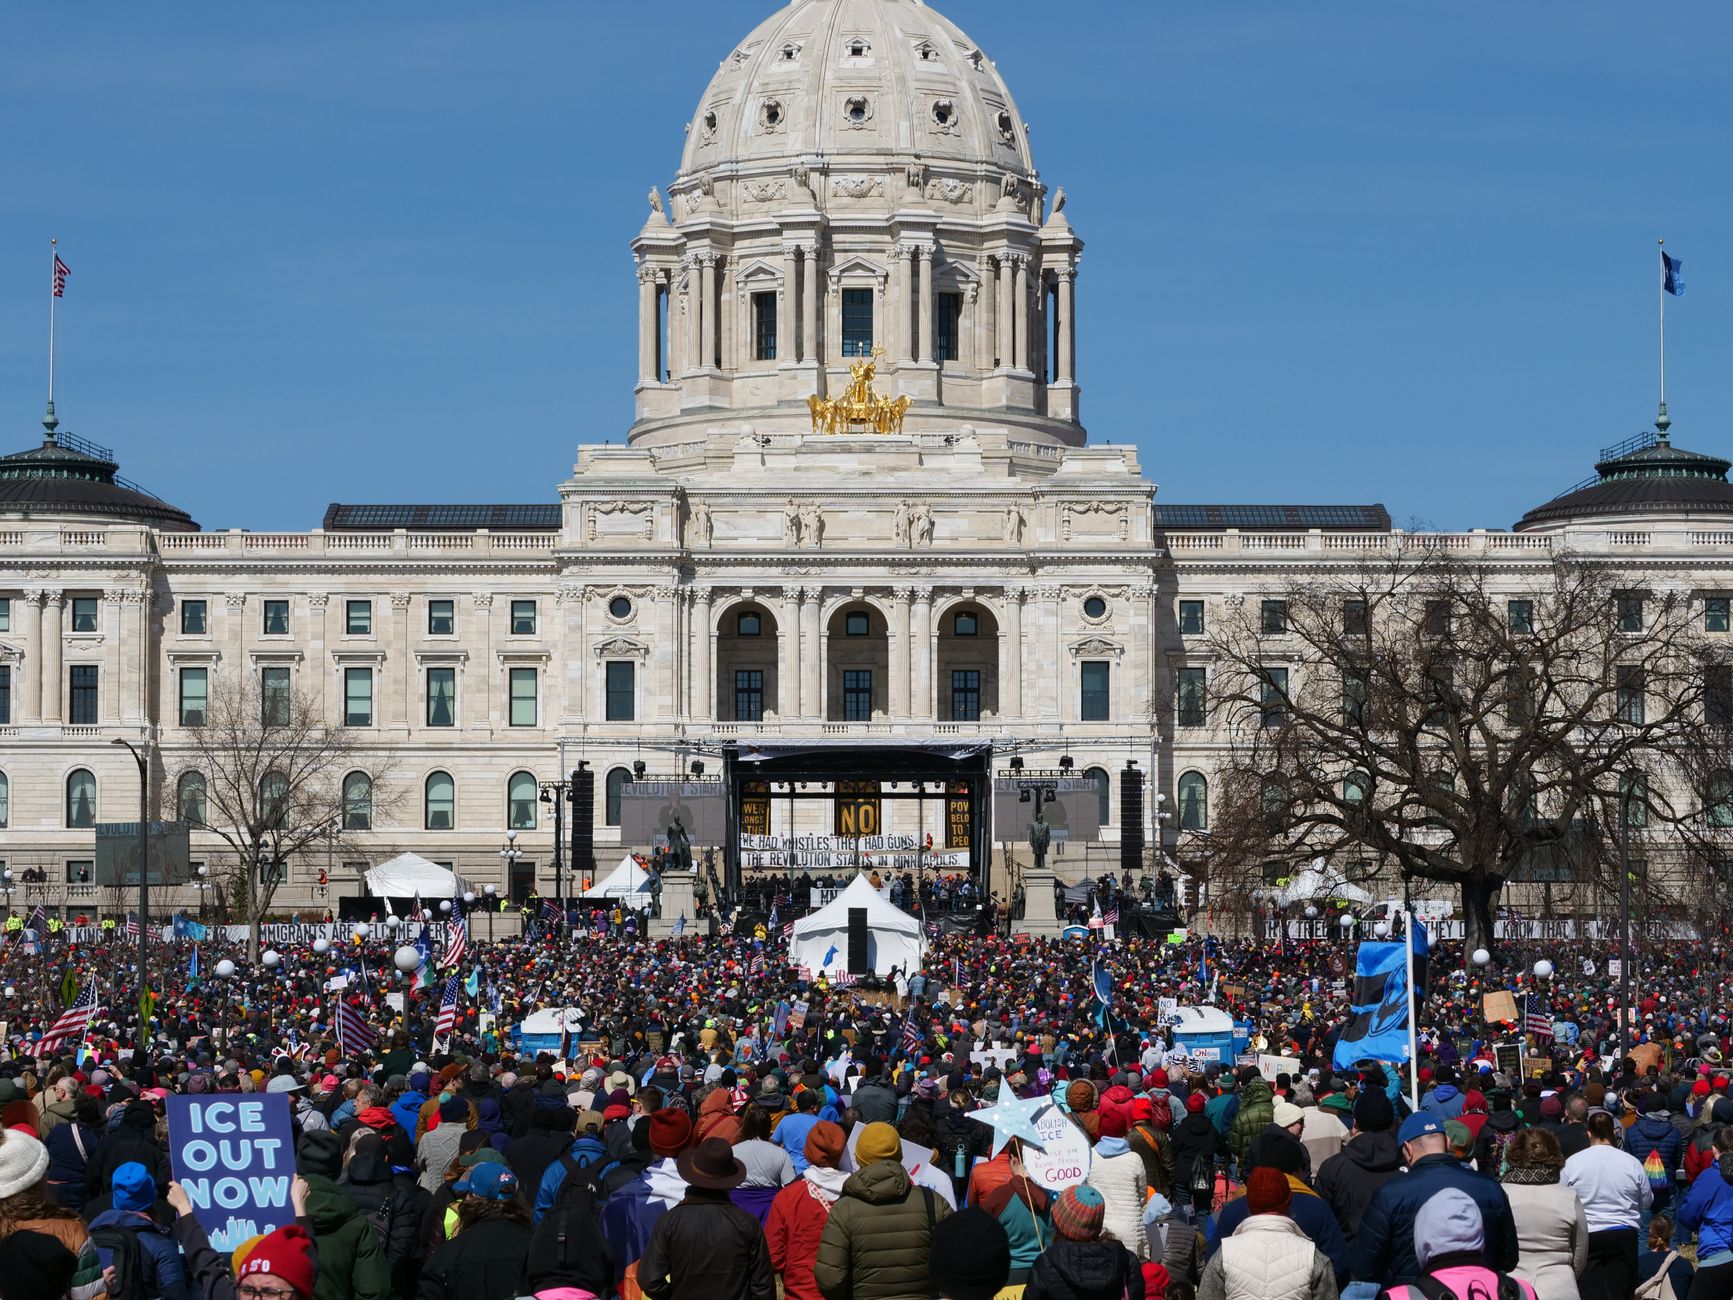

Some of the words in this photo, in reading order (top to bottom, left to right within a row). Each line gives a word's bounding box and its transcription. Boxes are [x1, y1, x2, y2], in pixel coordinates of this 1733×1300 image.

[743, 803, 764, 814] WER
[742, 815, 764, 823] LONGS
[841, 804, 875, 833] NO
[952, 813, 970, 823] BELO
[952, 824, 963, 835] TO
[742, 834, 754, 848] WE
[758, 836, 778, 849] HAD
[864, 836, 884, 850] HAD
[953, 836, 969, 846] PEO
[746, 852, 765, 866] THE
[770, 852, 831, 867] REVOLUTION
[878, 855, 888, 866] IN
[258, 923, 326, 943] MMIGRANTS
[332, 923, 354, 941] ARE
[190, 1102, 266, 1133] ICE
[1039, 1130, 1063, 1142] ICE
[182, 1138, 282, 1171] OUT
[1045, 1167, 1082, 1182] GOOD
[181, 1176, 289, 1209] NOW
